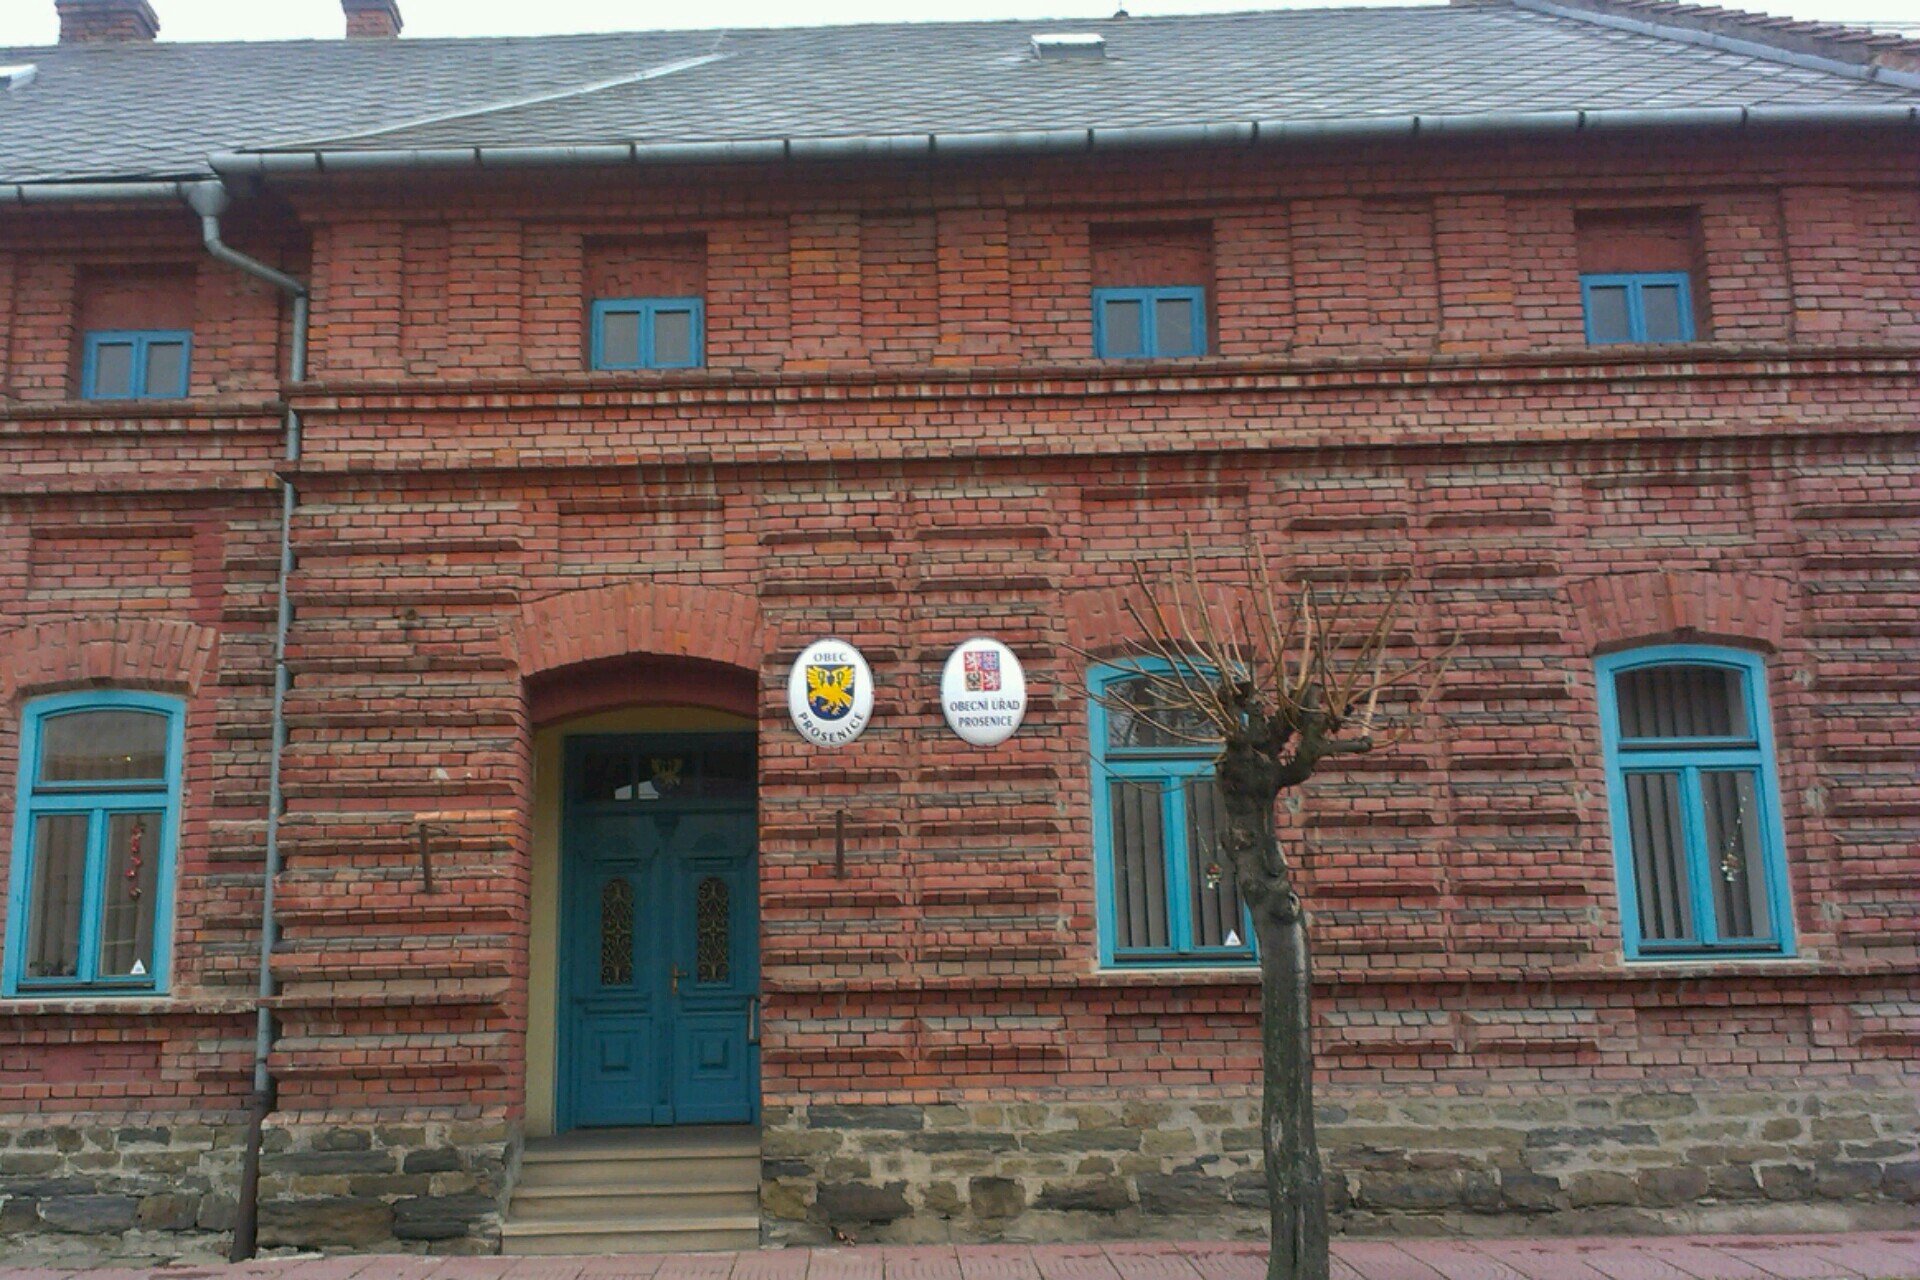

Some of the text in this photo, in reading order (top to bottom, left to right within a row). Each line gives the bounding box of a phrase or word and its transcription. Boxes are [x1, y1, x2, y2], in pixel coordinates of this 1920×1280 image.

[814, 652, 847, 662] OBEC
[798, 712, 864, 742] PROSENICE
[958, 716, 1013, 728] PROSENICE
